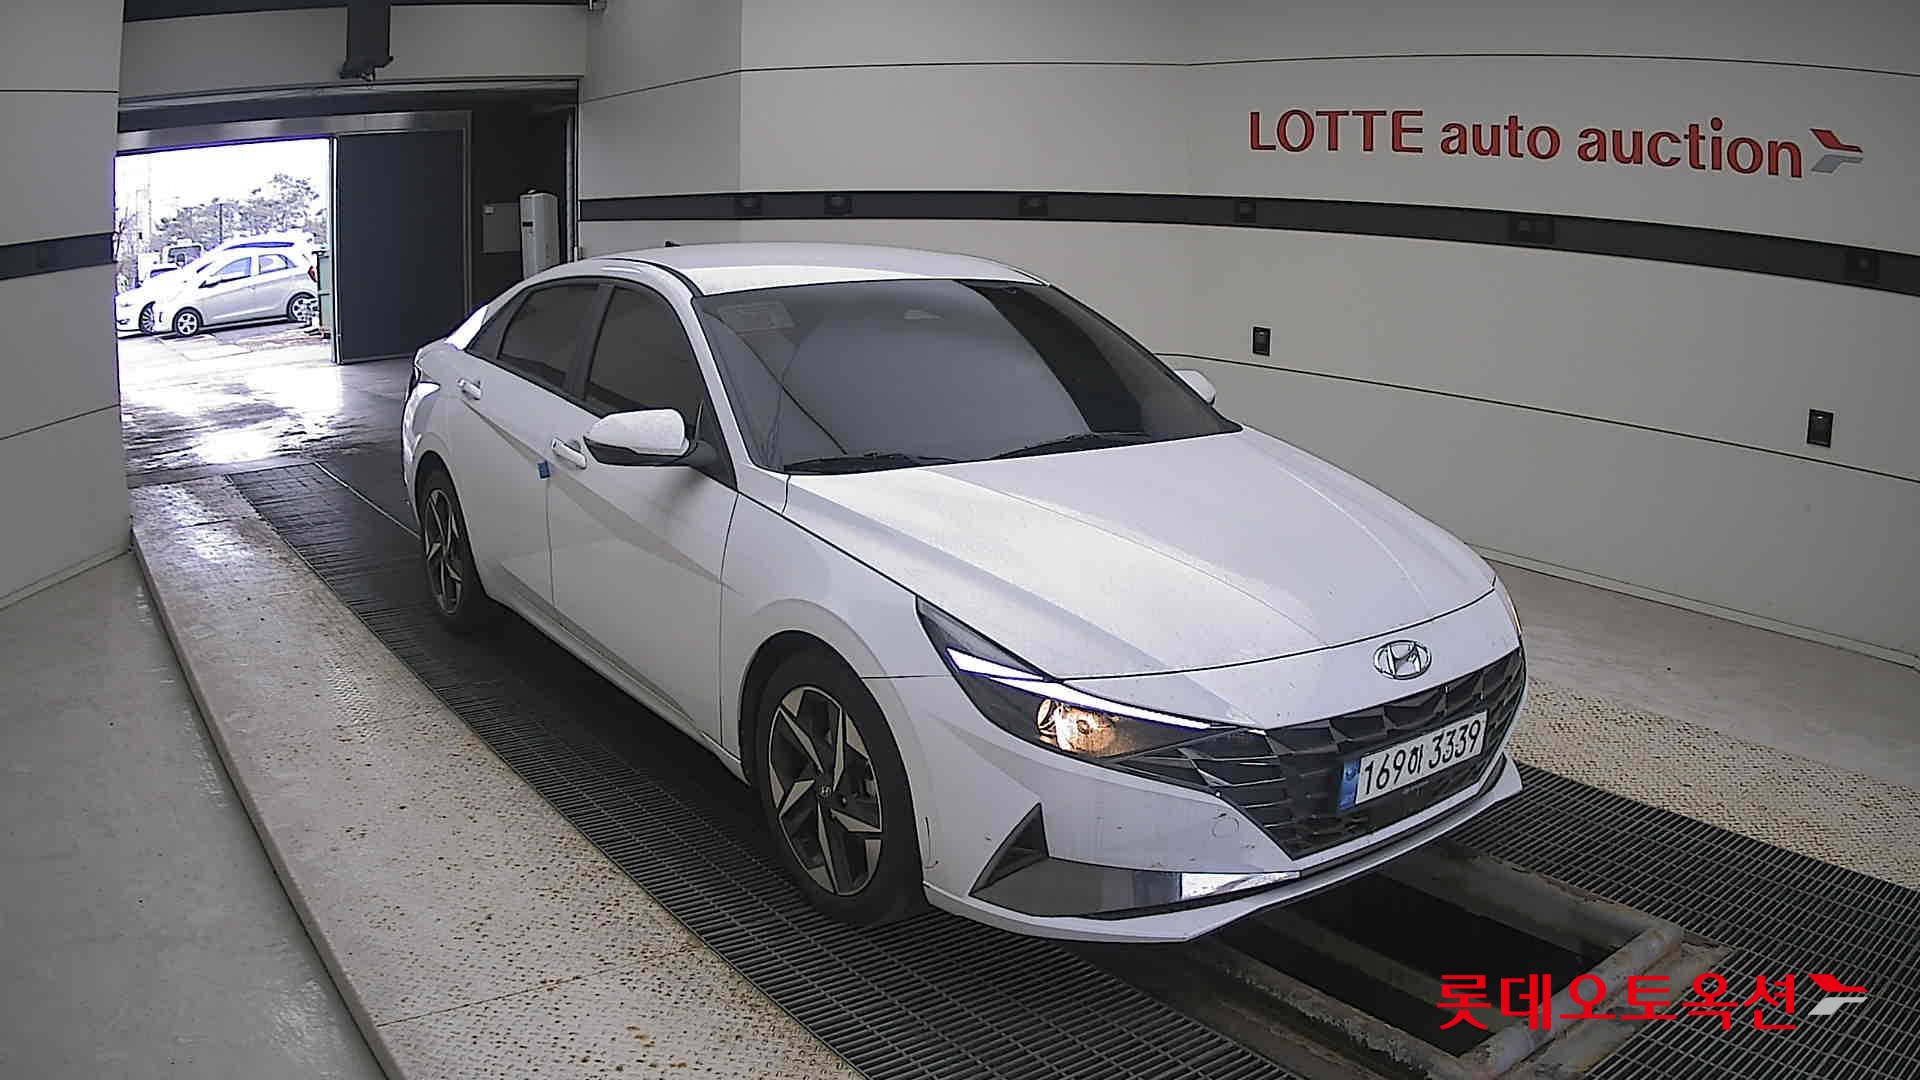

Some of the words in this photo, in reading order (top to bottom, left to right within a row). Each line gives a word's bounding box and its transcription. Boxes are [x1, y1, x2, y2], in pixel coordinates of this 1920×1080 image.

[1249, 109, 1424, 154] LOTTE
[1440, 114, 1561, 161] auto
[1576, 116, 1803, 179] auction
[1428, 719, 1481, 769] 3339
